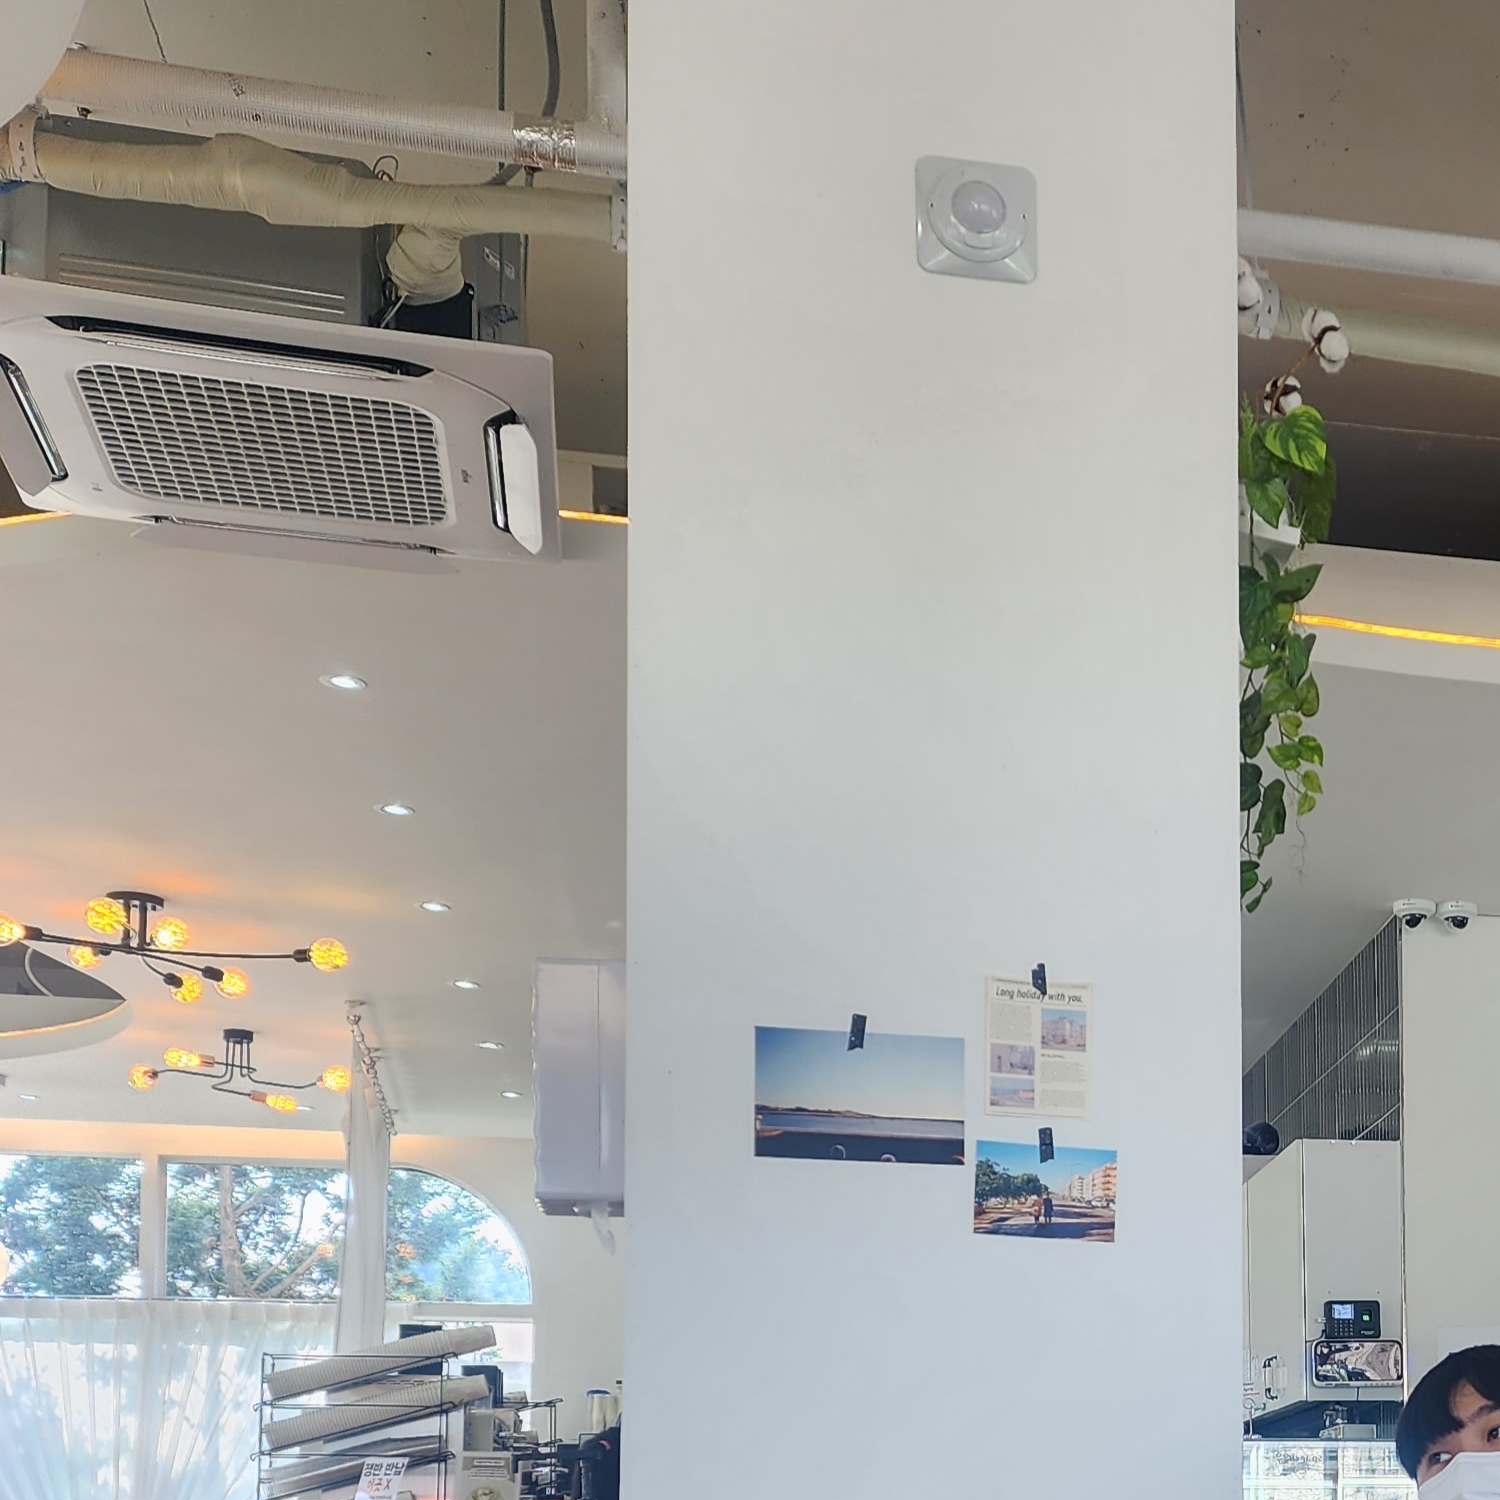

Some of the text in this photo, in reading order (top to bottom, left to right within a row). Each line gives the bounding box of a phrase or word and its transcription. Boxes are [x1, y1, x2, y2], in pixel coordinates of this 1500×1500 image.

[995, 986, 1014, 1000] Long
[1016, 987, 1045, 1003] holiday
[1048, 992, 1066, 1002] with
[383, 1461, 405, 1477] 반납
